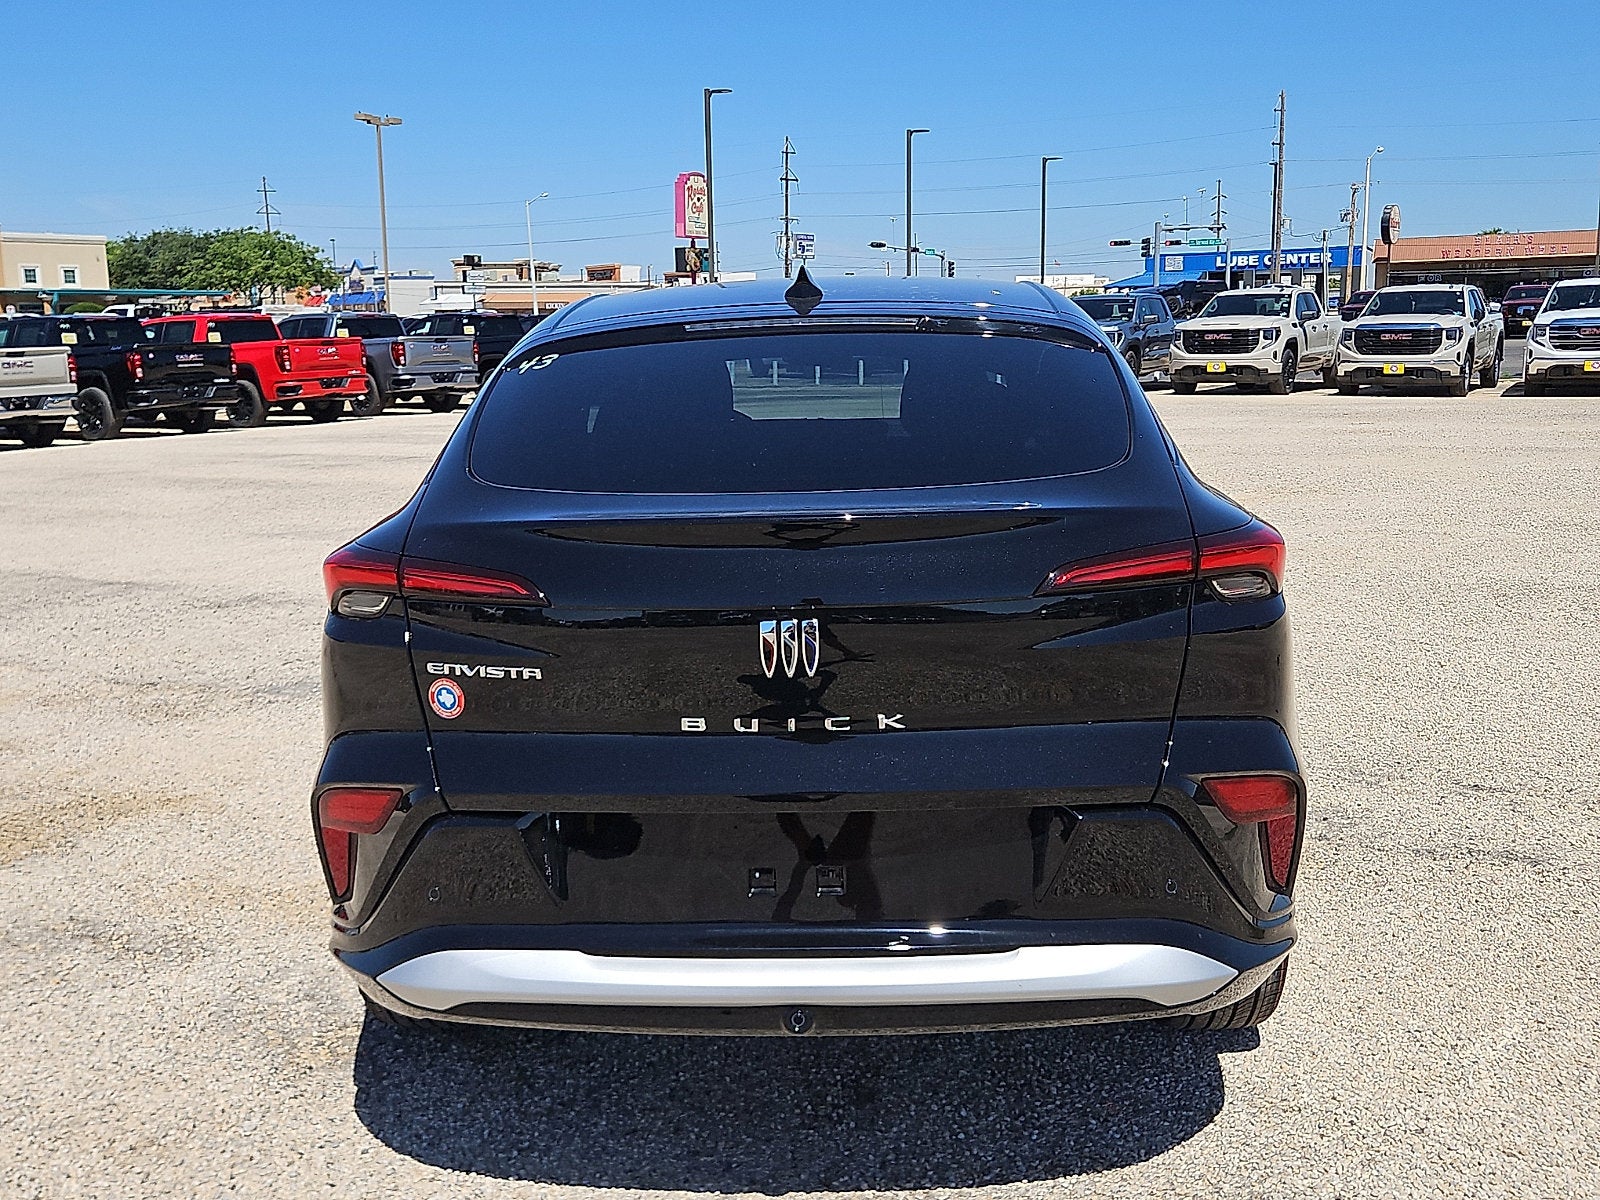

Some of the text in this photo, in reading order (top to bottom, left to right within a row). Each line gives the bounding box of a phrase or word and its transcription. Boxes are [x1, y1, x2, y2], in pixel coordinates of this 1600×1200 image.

[1263, 252, 1333, 266] CENTER
[426, 662, 542, 680] ENVISTA
[681, 713, 906, 732] BUICK
